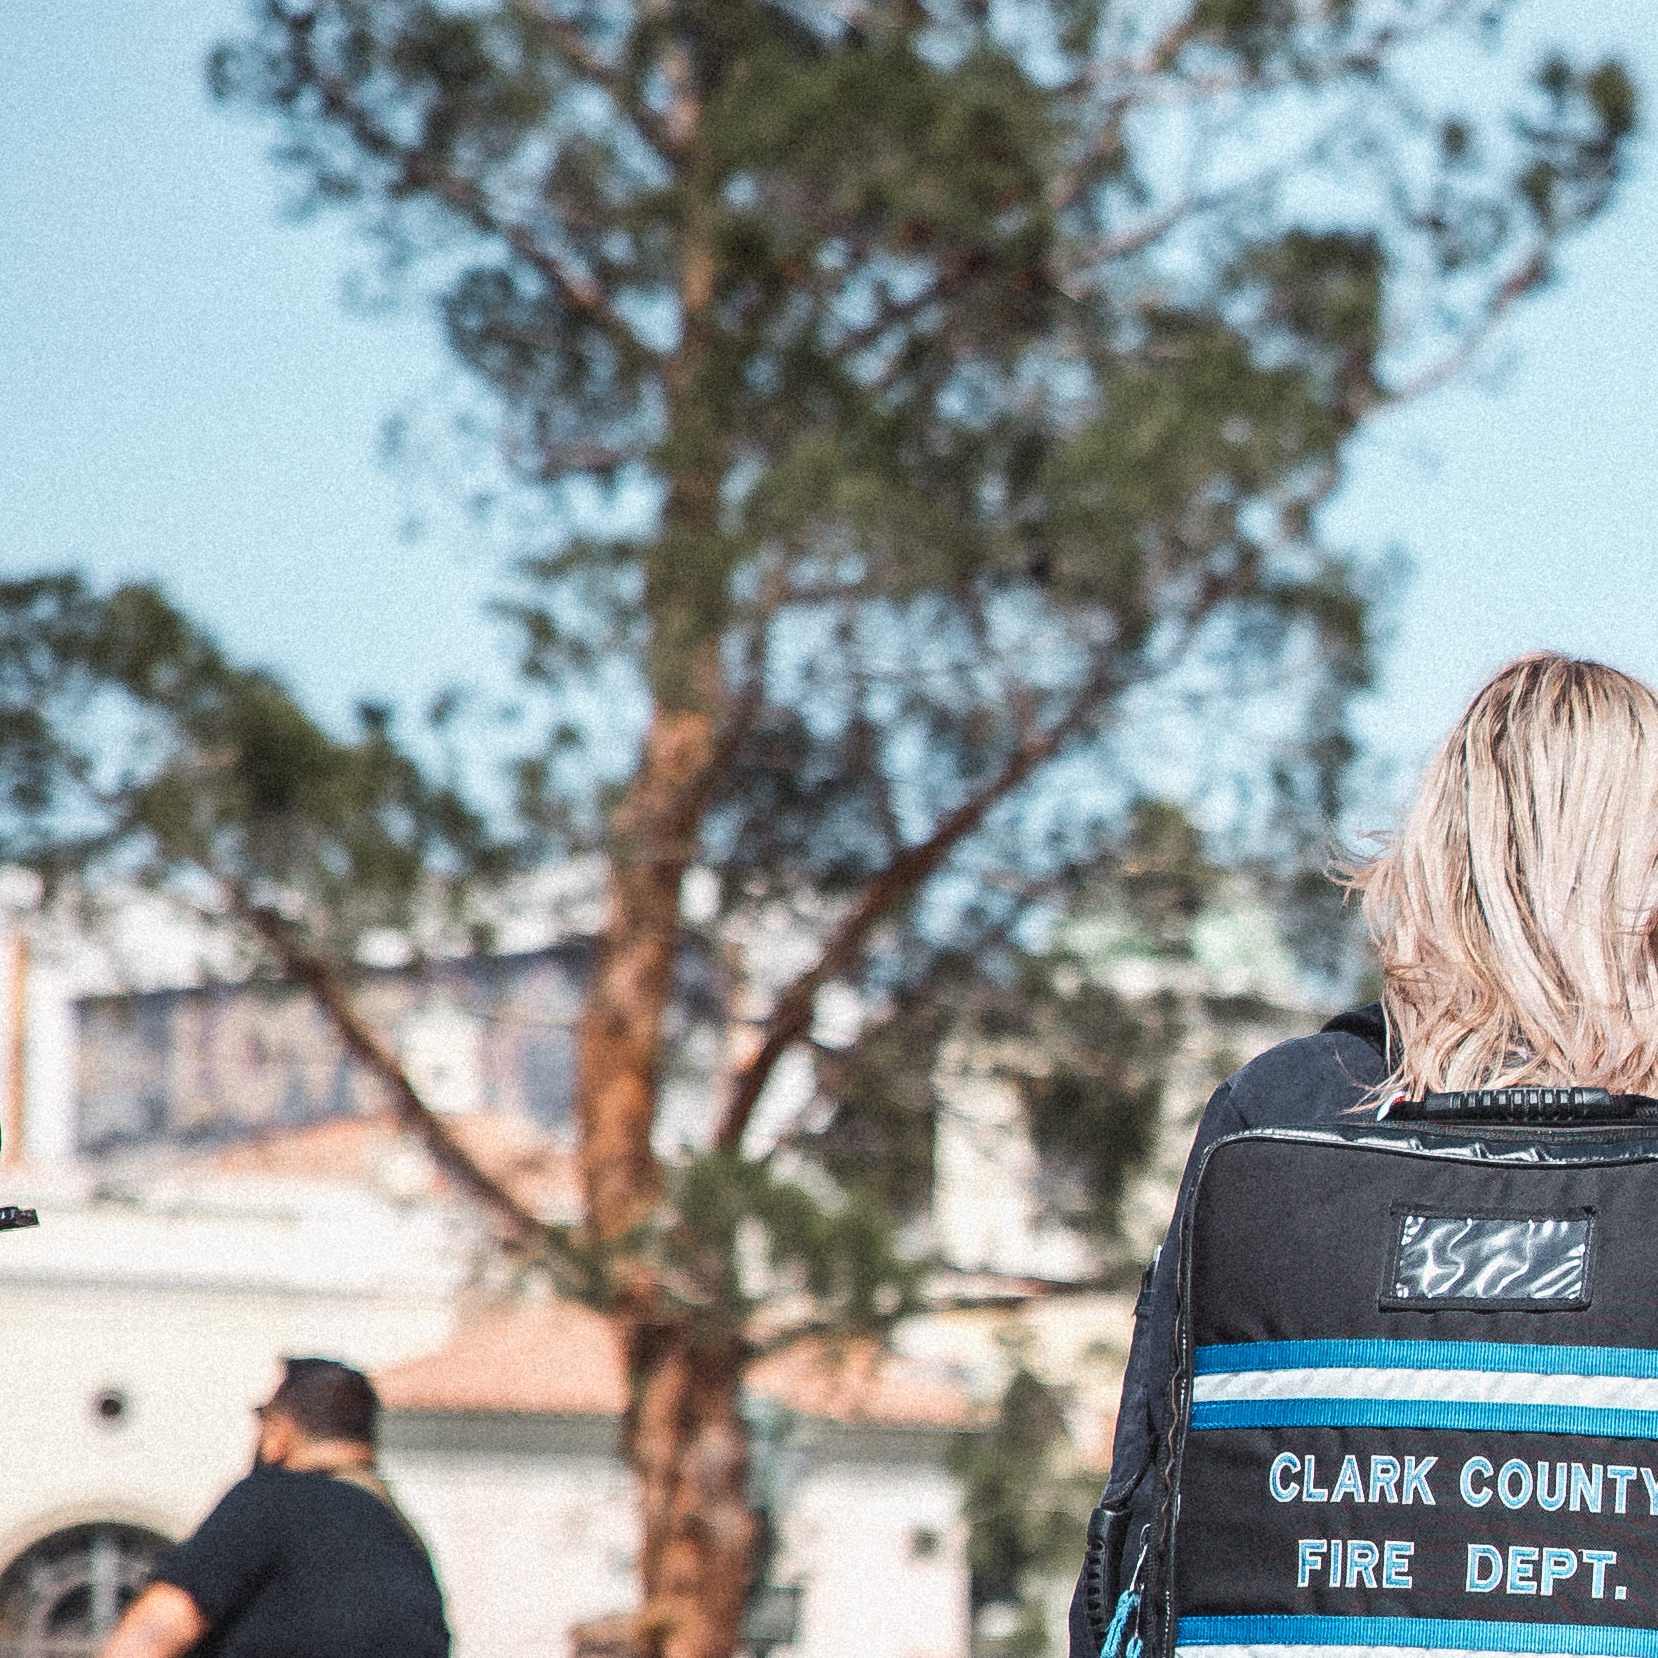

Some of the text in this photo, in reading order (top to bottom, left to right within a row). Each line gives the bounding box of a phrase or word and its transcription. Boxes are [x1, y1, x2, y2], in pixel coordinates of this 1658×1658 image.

[1268, 1451, 1439, 1506] CLARK
[1296, 1538, 1628, 1601] FIRE DEPT.
